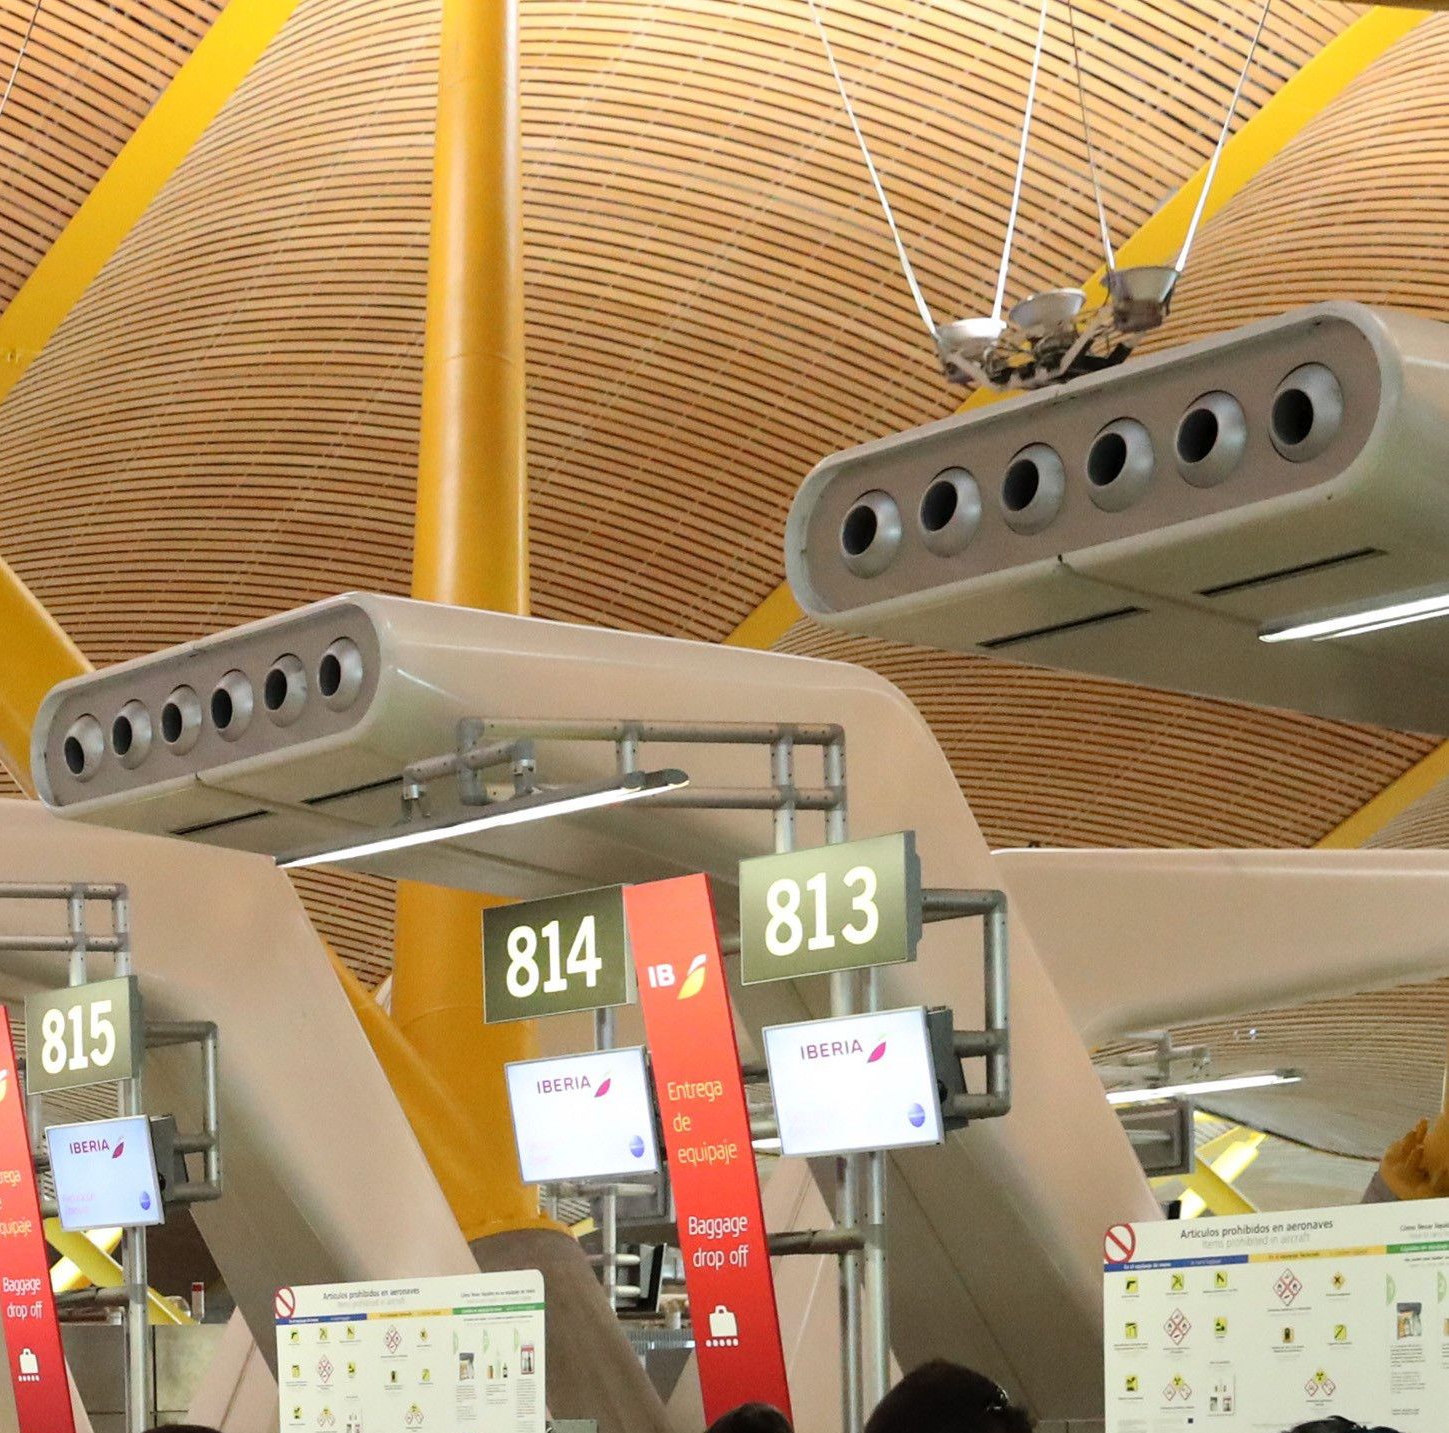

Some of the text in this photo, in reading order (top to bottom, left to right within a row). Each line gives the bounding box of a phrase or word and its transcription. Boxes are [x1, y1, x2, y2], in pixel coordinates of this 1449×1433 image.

[765, 865, 880, 957] 813
[505, 914, 603, 999] 814
[647, 962, 676, 988] IB
[41, 999, 117, 1075] 815
[800, 1038, 863, 1061] IBERIA
[536, 1074, 592, 1095] IBERIA
[666, 1079, 723, 1103] Entrega
[672, 1112, 692, 1133] de
[69, 1139, 110, 1155] IBERIA
[677, 1141, 738, 1168] equipaje
[687, 1215, 749, 1240] Baggage
[1221, 1223, 1271, 1237] prohibidos
[1272, 1222, 1284, 1233] en
[1286, 1219, 1334, 1231] aeronaves
[692, 1244, 749, 1270] drop off
[2, 1276, 42, 1296] Baggage
[6, 1300, 44, 1321] drop off
